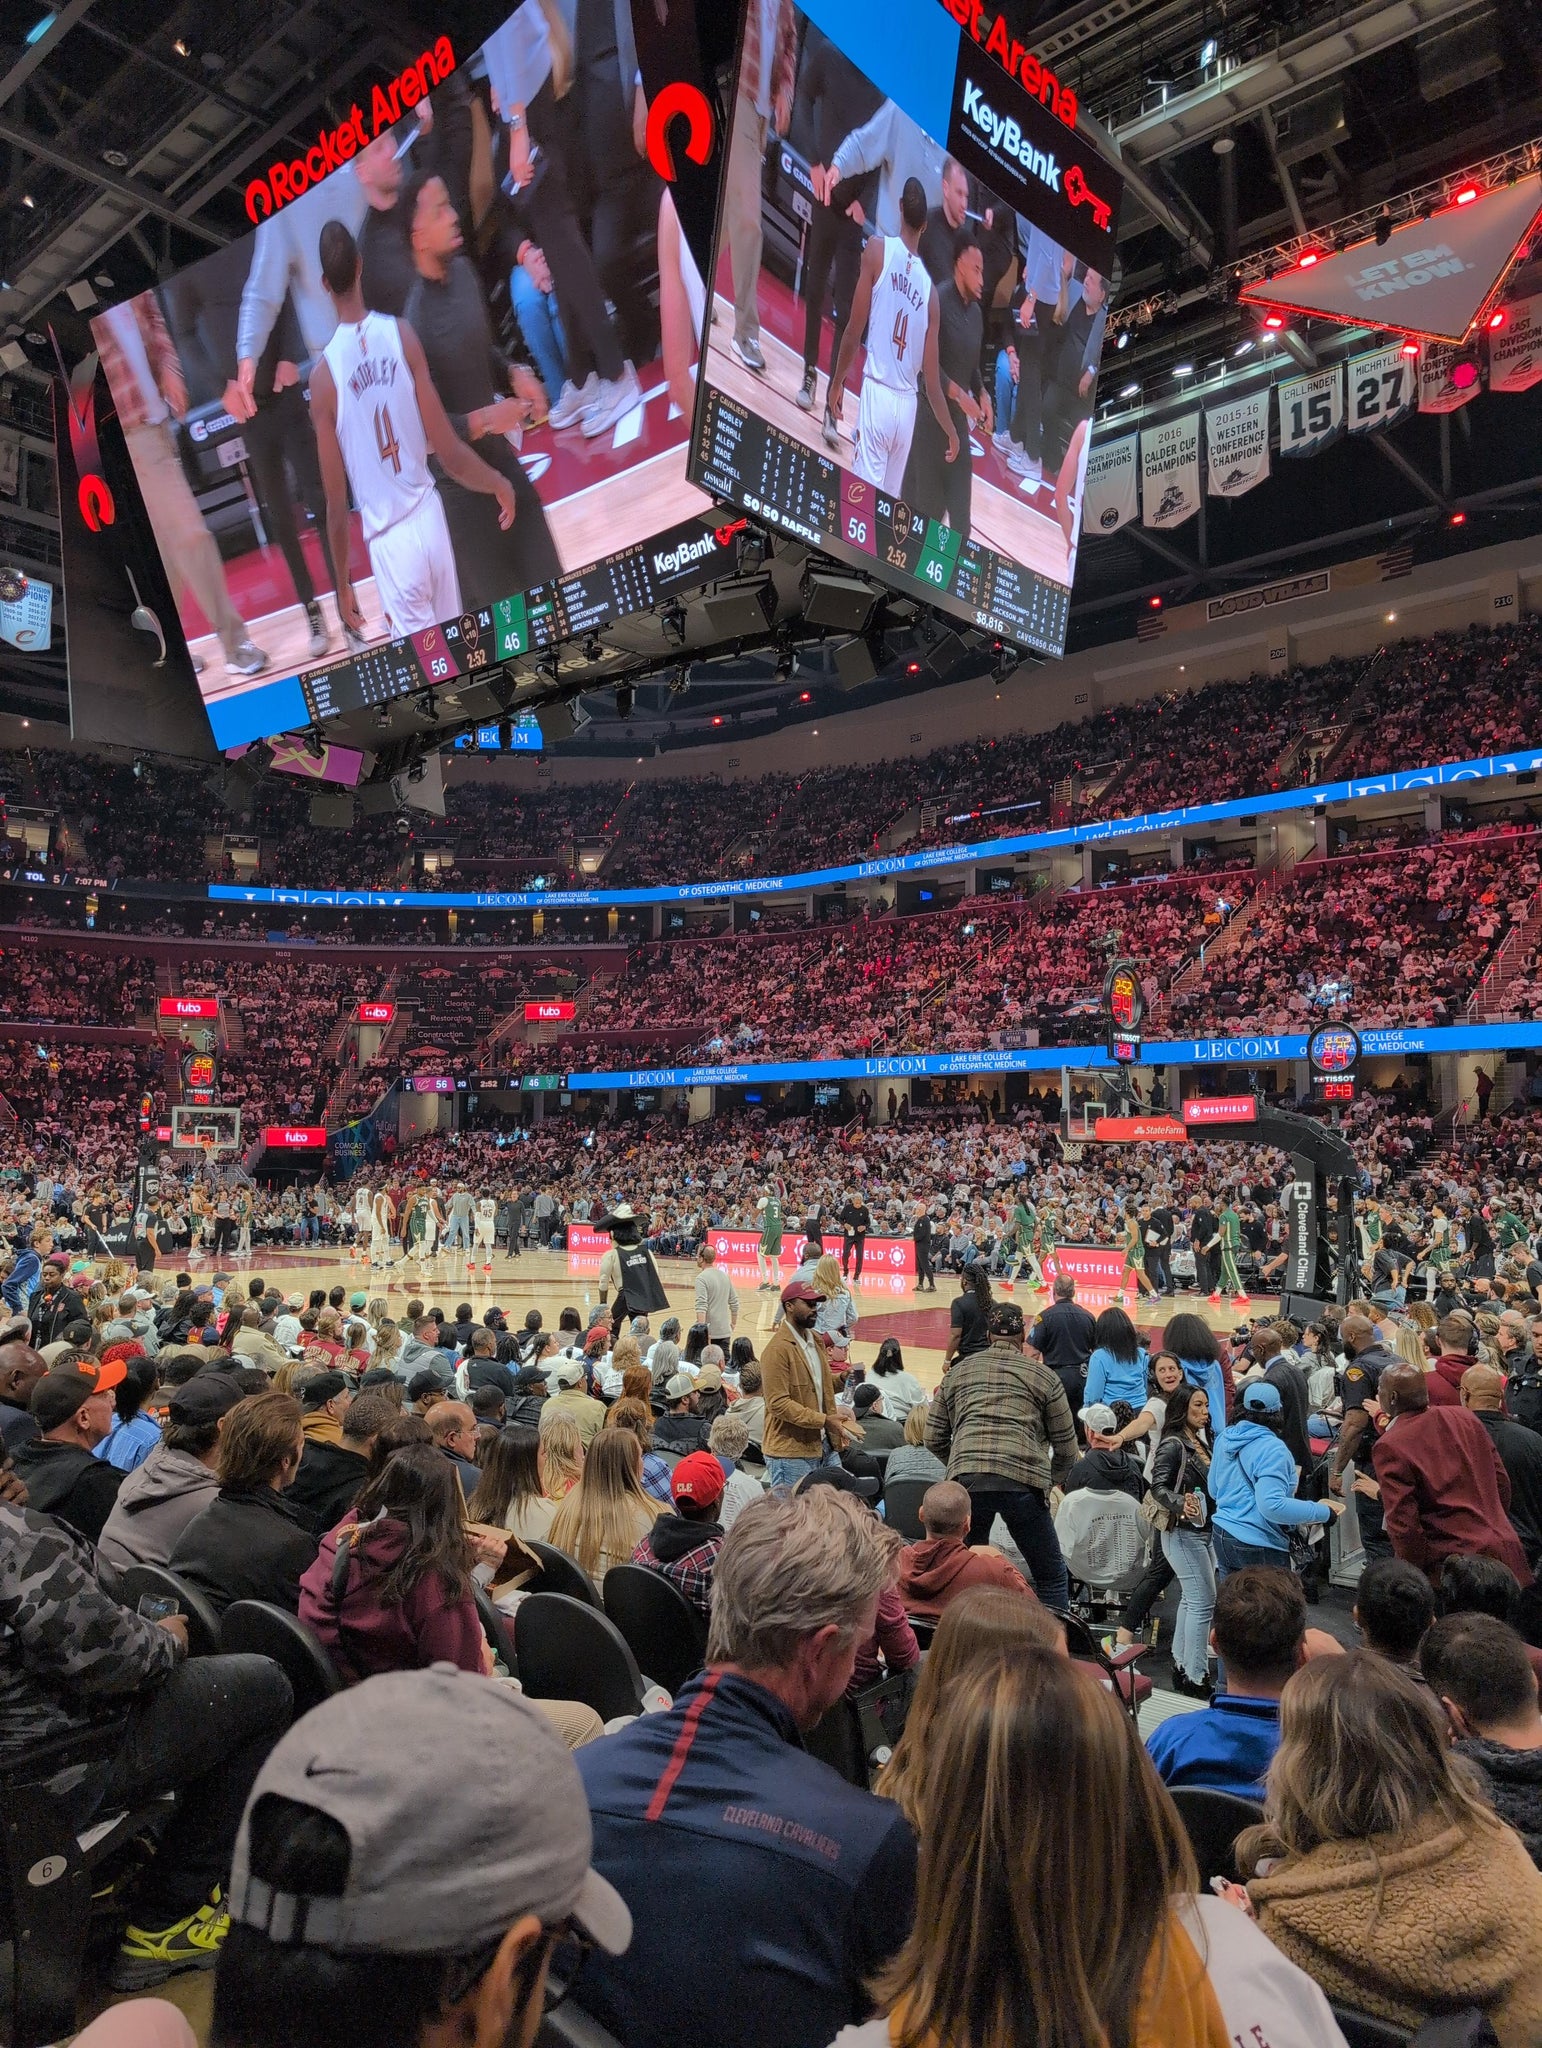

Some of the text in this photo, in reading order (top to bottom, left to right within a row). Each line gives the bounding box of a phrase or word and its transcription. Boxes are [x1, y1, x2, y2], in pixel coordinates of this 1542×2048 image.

[985, 14, 1077, 129] Arena
[268, 35, 456, 208] Rocket Arena
[963, 79, 1062, 192] KeyBank
[1344, 243, 1454, 287] LET EM
[891, 272, 924, 311] MOBLEY
[893, 308, 909, 362] 4
[1284, 375, 1337, 400] CALLANDER
[1357, 367, 1404, 419] 27
[720, 396, 748, 419] CAVALIERS
[1216, 403, 1259, 427] 2015-16
[1291, 391, 1331, 440] 15
[718, 408, 743, 428] MOBLEY
[374, 400, 401, 477] 4
[717, 420, 742, 441] MERRILL
[1158, 427, 1182, 444] 2016
[1217, 419, 1259, 441] WESTERN
[716, 433, 735, 450] ALLEN
[778, 433, 811, 457] REB AST FLS
[1145, 436, 1197, 464] CALDER CUP
[1210, 430, 1266, 456] CONFERENCE
[714, 445, 732, 461] WADE
[1088, 446, 1129, 465] NORTH DIVISION
[1213, 443, 1263, 468] CHAMPIONS
[713, 457, 740, 480] MITCHELL
[818, 457, 834, 471] FOULS
[1086, 453, 1132, 476] CHAMPIONS
[1146, 451, 1197, 477] CHAMPIONS
[704, 471, 732, 493] oswald
[877, 500, 891, 517] 2Q
[809, 514, 819, 525] TOL
[912, 516, 923, 534] 24
[781, 515, 821, 544] RAFFLE
[848, 517, 867, 543] 56
[653, 533, 717, 575] KeyBank
[966, 541, 981, 552] FOULS
[887, 546, 907, 568] 2:52
[963, 560, 976, 570] BONUS
[926, 560, 943, 583] 46
[997, 566, 1018, 582] TURNER
[562, 581, 582, 594] TURNER
[994, 586, 1013, 599] GREEN
[996, 576, 1021, 594] TRENT JR.
[565, 593, 581, 603] TRENT
[1495, 596, 1512, 606] 210
[567, 602, 584, 613] GREEN
[992, 606, 1024, 625] JACKSON JR.
[479, 611, 490, 627] 24
[572, 619, 593, 632] JACKSON
[446, 626, 459, 640] 2Q
[504, 632, 520, 651] 46
[976, 611, 1062, 656] $8,816 CAVS5050.COM
[467, 649, 487, 669] 2:52
[1271, 649, 1286, 658] 209
[431, 658, 448, 677] 56
[316, 693, 330, 702] ALLEN
[318, 701, 331, 709] WADE
[320, 707, 340, 718] MITCHELL
[922, 852, 978, 866] OSTEOPATHIC MEDICINE
[935, 850, 946, 858] ERIE
[946, 848, 968, 856] COLLEGE
[859, 859, 906, 875] LECOM
[3, 870, 108, 888] 4 TOL 5 7:07 PM
[691, 883, 743, 895] OSTEOPATHIC
[745, 880, 783, 891] MEDICINE
[477, 895, 528, 905] LECOM
[1115, 980, 1132, 995] 2:52
[177, 1002, 201, 1013] fubo
[539, 1006, 560, 1017] fubo
[1112, 994, 1132, 1024] 24
[1363, 1032, 1404, 1042] COLLEGE
[1378, 1041, 1424, 1050] MEDICINE
[969, 1054, 982, 1062] ERIE
[983, 1053, 1013, 1061] COLLEGE
[1194, 1040, 1280, 1058] LECOM
[194, 1059, 213, 1069] 2:52
[866, 1058, 927, 1074] LECOM
[950, 1062, 993, 1071] OSTEOPATHIC
[994, 1060, 1027, 1068] MEDICINE
[1322, 1051, 1347, 1066] 24
[191, 1067, 211, 1086] 24
[436, 1080, 448, 1089] 56
[480, 1080, 498, 1088] 2:52
[529, 1078, 539, 1087] 46
[629, 1072, 675, 1085] LECOM
[1325, 1084, 1353, 1098] 2:43
[1203, 1106, 1247, 1114] WESTFIELD
[285, 1132, 308, 1142] fubo
[483, 1209, 492, 1217] 45
[773, 1207, 779, 1218] 3
[1296, 1202, 1309, 1288] Cleveland Clinic
[1066, 1263, 1121, 1274] WESTFIEL
[676, 1483, 693, 1492] CLE
[723, 1806, 842, 1862] CLEVELAND CAVALIERS
[42, 1861, 52, 1878] 6
